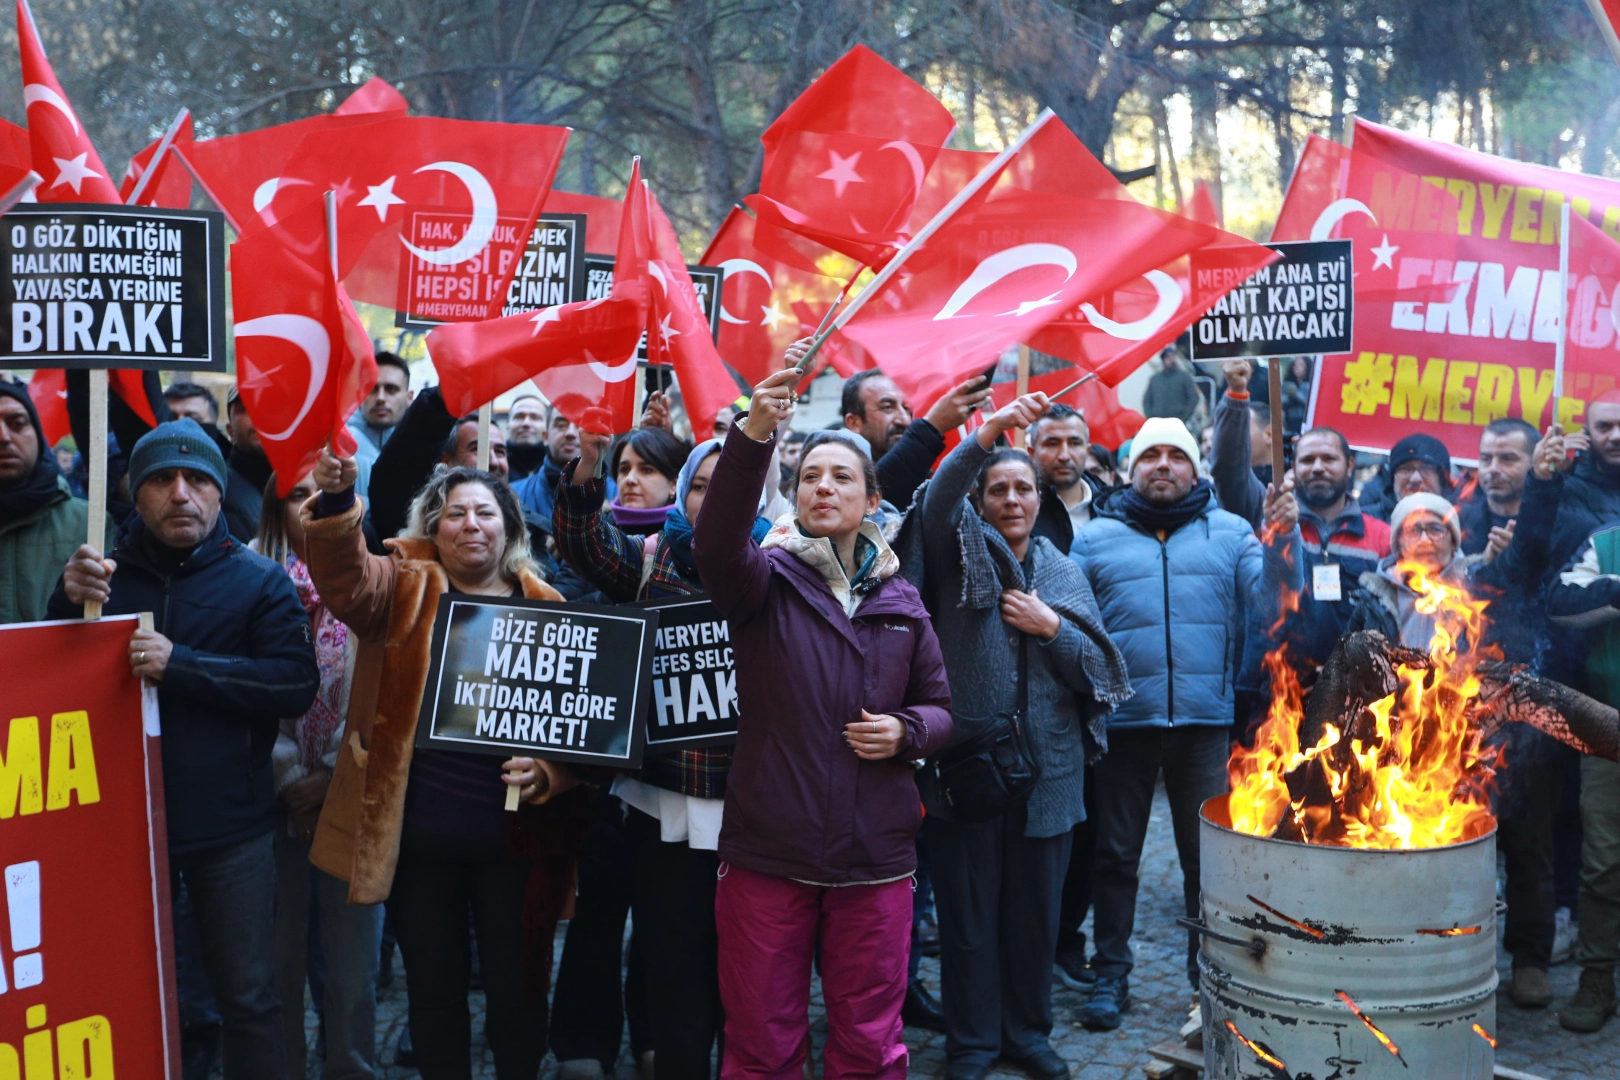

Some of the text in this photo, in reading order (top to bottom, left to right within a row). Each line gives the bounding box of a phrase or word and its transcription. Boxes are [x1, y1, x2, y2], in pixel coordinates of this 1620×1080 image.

[11, 219, 182, 251] O GÖZ DİKTİĞİN
[421, 221, 457, 241] HAK,
[12, 251, 182, 277] HALKIN EKMEĞİNİ
[418, 244, 490, 274] HEPSİ
[1197, 256, 1346, 289] MERYEM ANA EVİ
[12, 276, 182, 302] YAVAŞCA YERİNE
[416, 272, 479, 300] HEPSİ
[588, 269, 614, 282] SEZA
[1267, 283, 1346, 313] KAPISI
[12, 301, 183, 353] BIRAK!
[1199, 311, 1345, 345] OLMAYACAK!
[491, 612, 599, 650] BİZE GÖRE
[484, 642, 597, 687] MABET
[652, 652, 691, 675] EFES
[454, 674, 617, 721] İKTİDARA GÖRE
[475, 709, 588, 748] MARKET!
